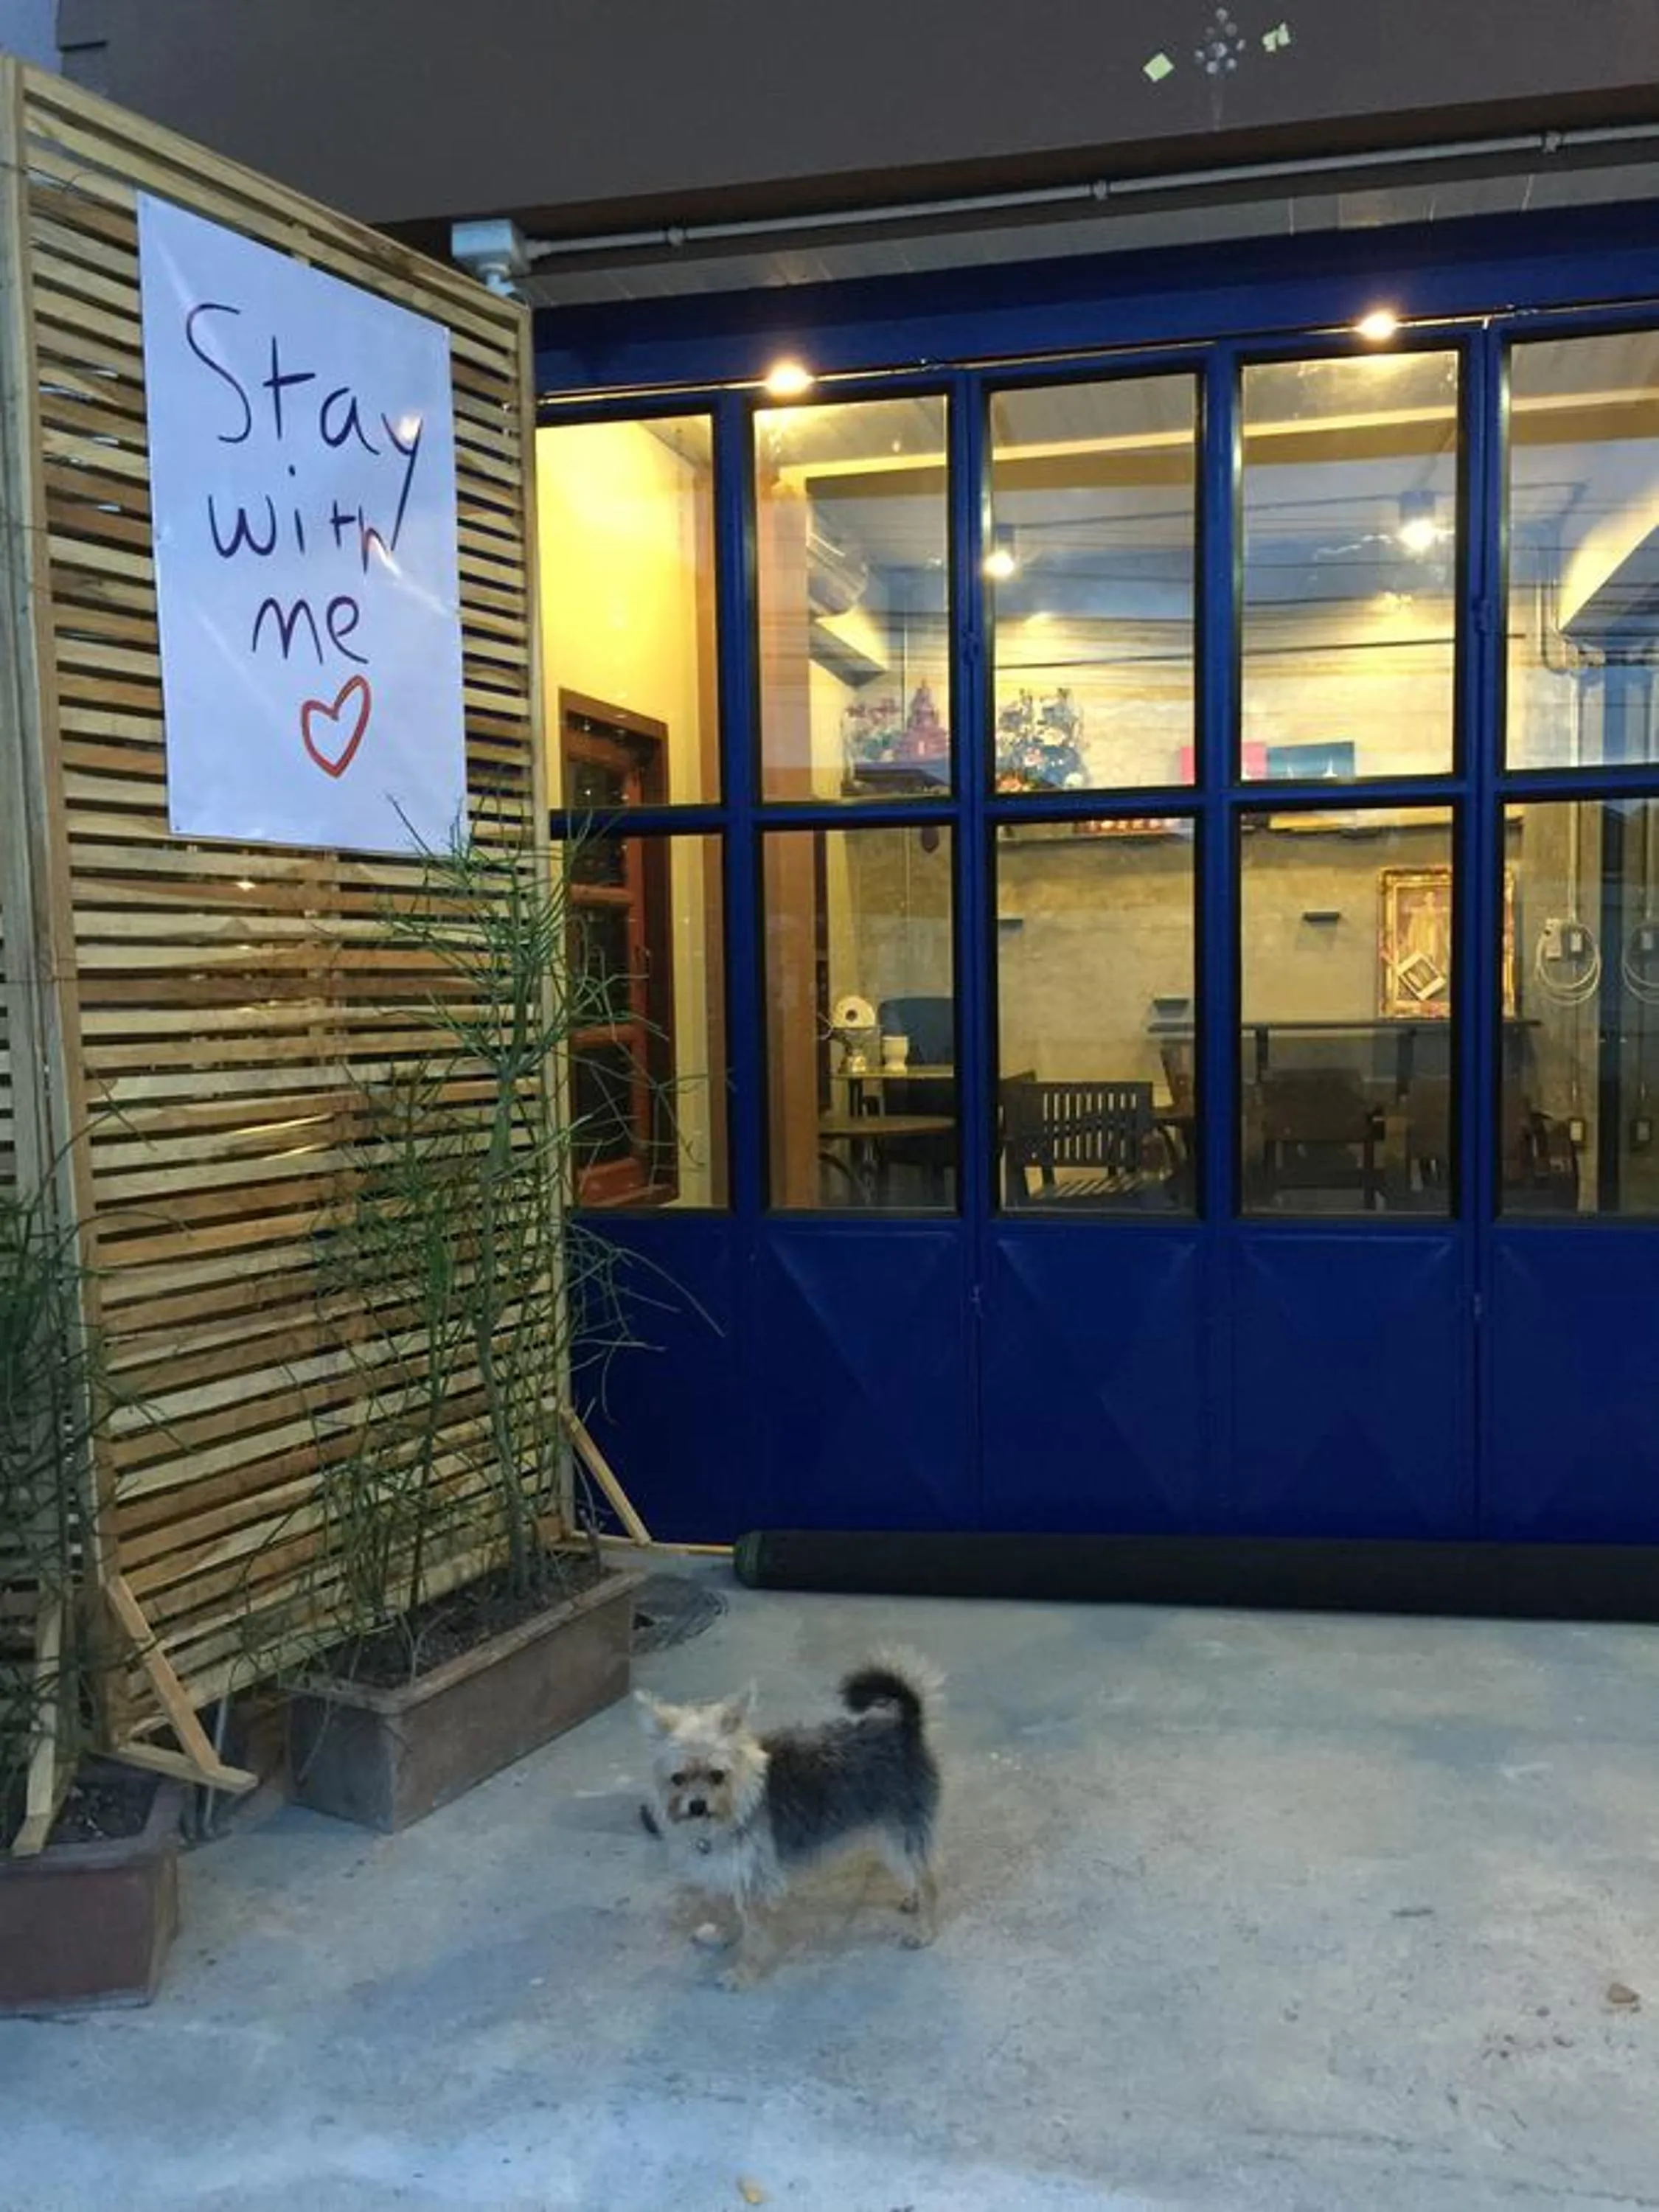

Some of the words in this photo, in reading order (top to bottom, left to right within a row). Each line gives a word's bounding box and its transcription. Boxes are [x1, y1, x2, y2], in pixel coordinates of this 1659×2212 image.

[186, 303, 423, 552] Stay
[208, 465, 391, 574] with
[251, 596, 368, 664] me
